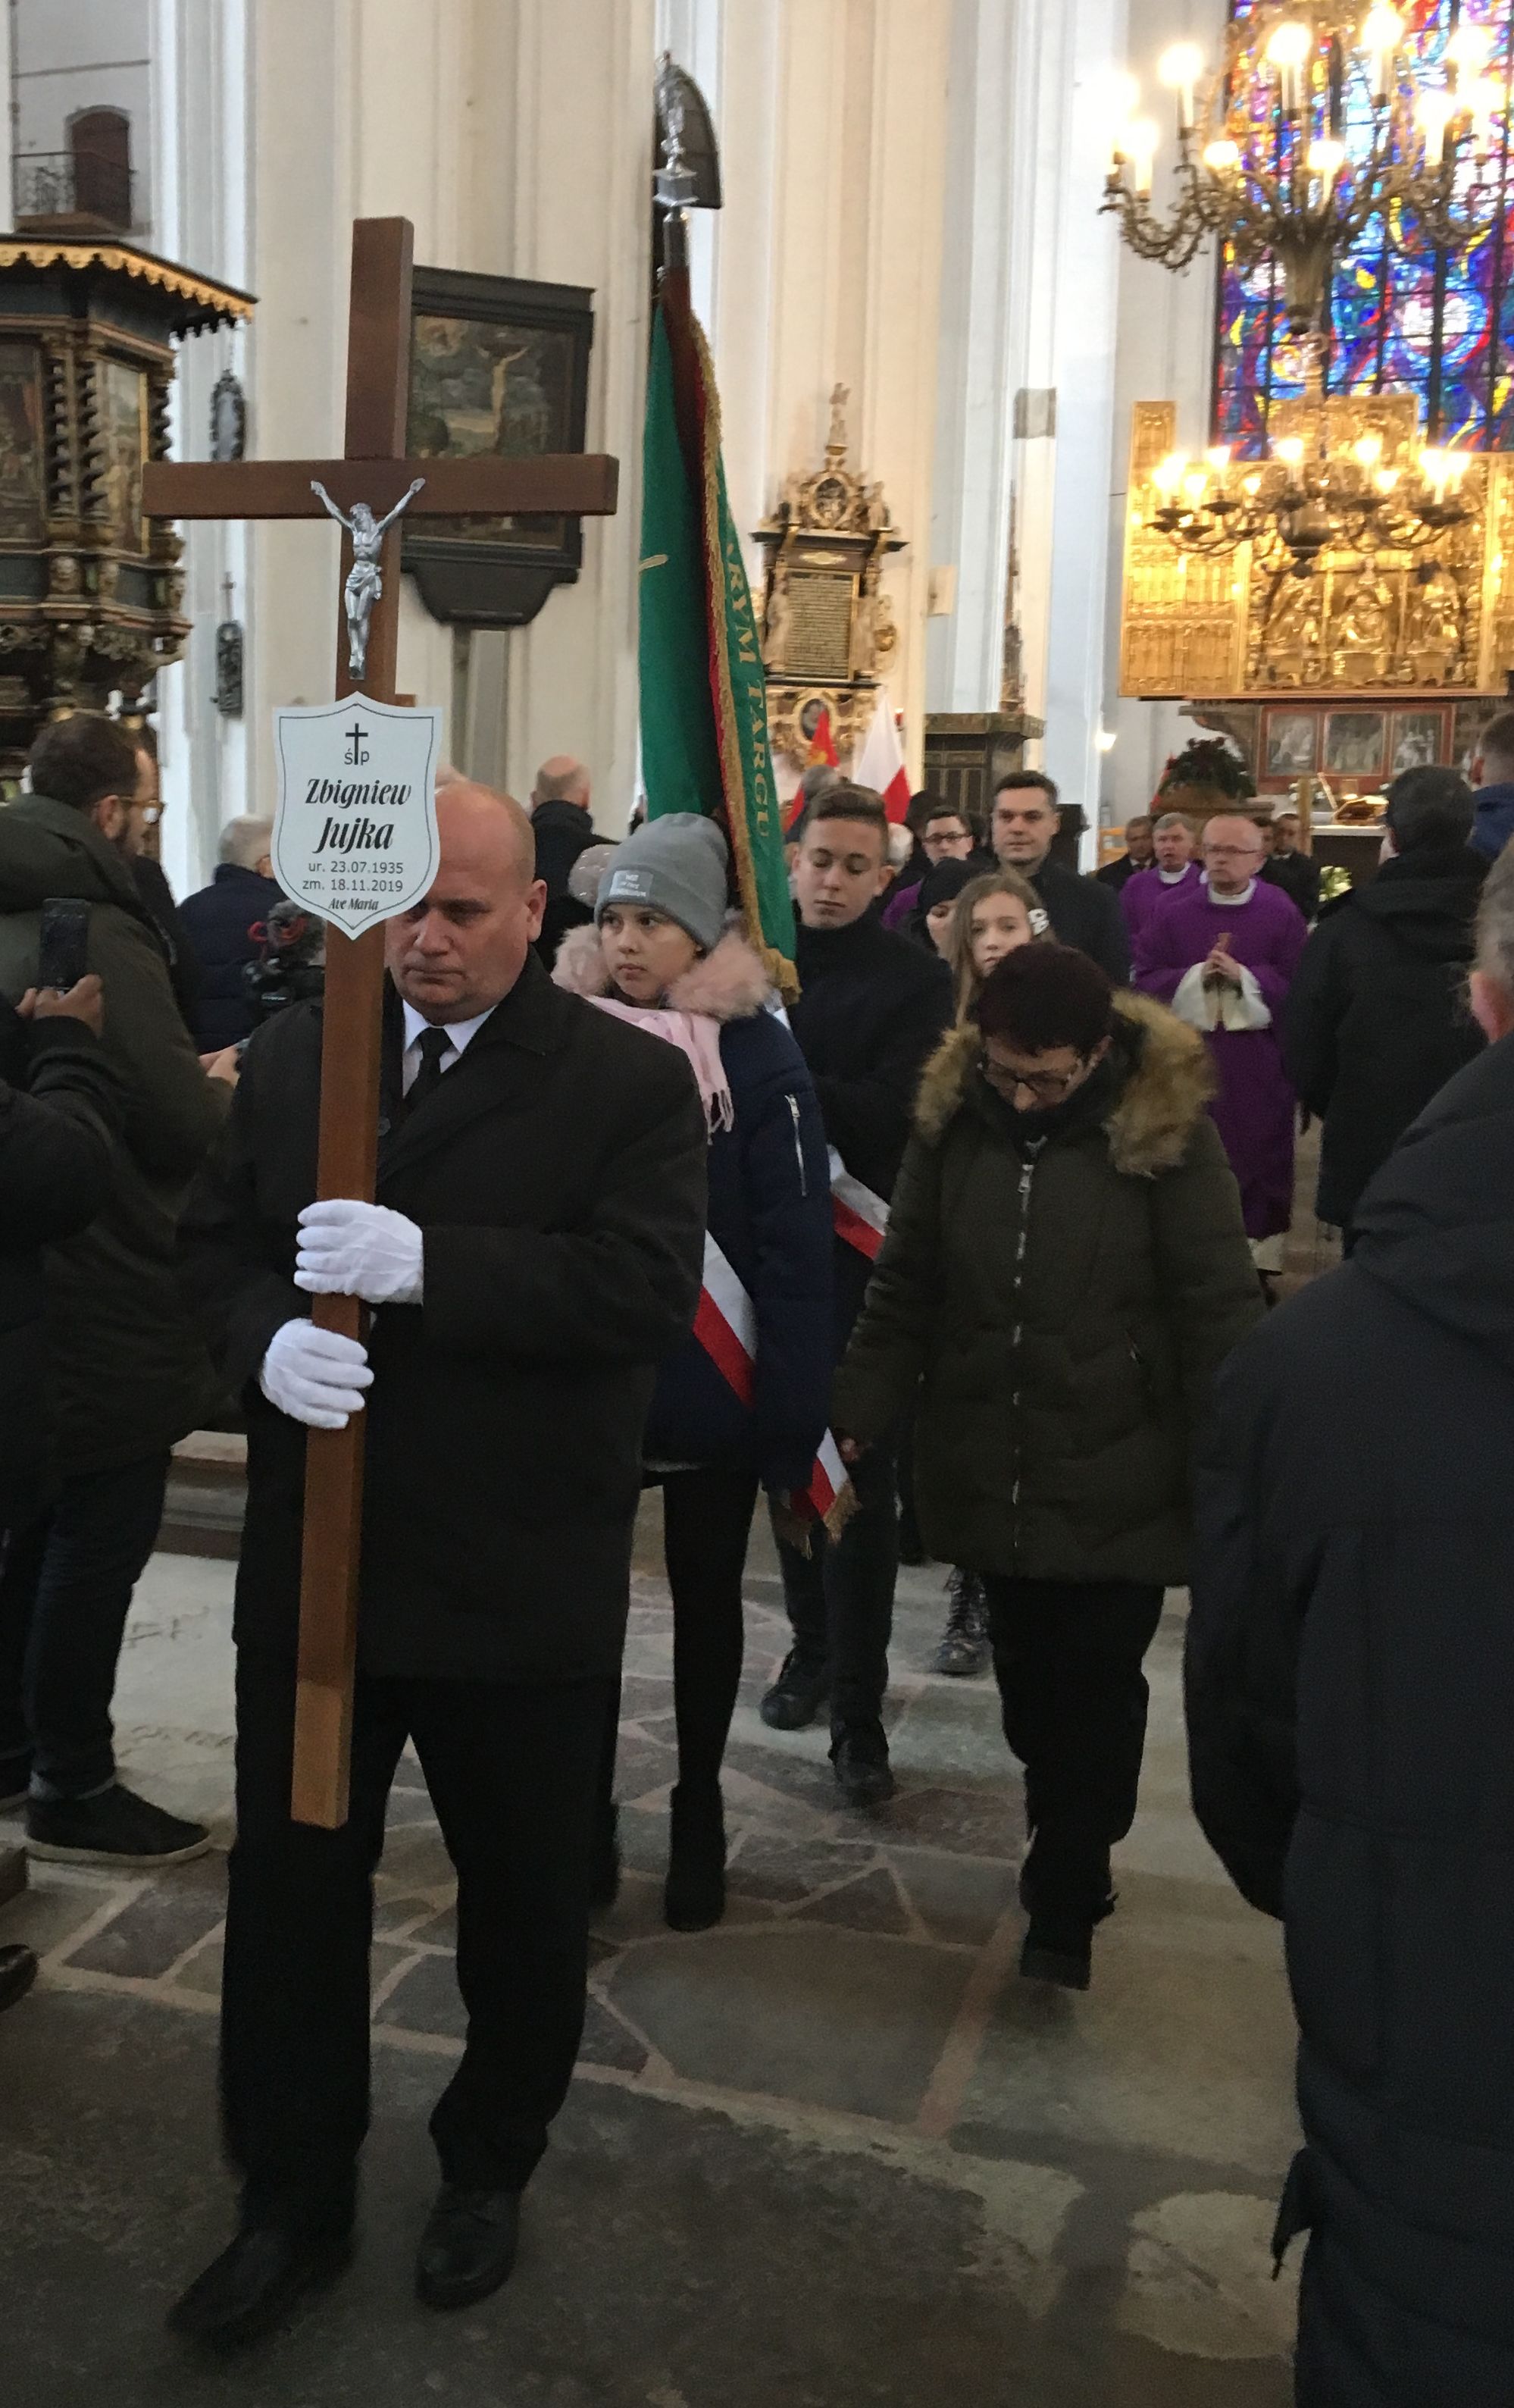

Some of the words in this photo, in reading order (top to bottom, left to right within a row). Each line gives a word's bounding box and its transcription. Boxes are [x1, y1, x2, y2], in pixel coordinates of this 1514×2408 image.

[748, 679, 769, 837] TARGU
[305, 778, 411, 809] Zbigniew
[312, 816, 395, 854] Jujka
[308, 863, 325, 872] ur.
[330, 860, 403, 874] 23.07.1935
[303, 881, 324, 890] zm.
[331, 878, 403, 892] 18.11.2019
[328, 898, 346, 910] Ave
[349, 898, 379, 911] Maria
